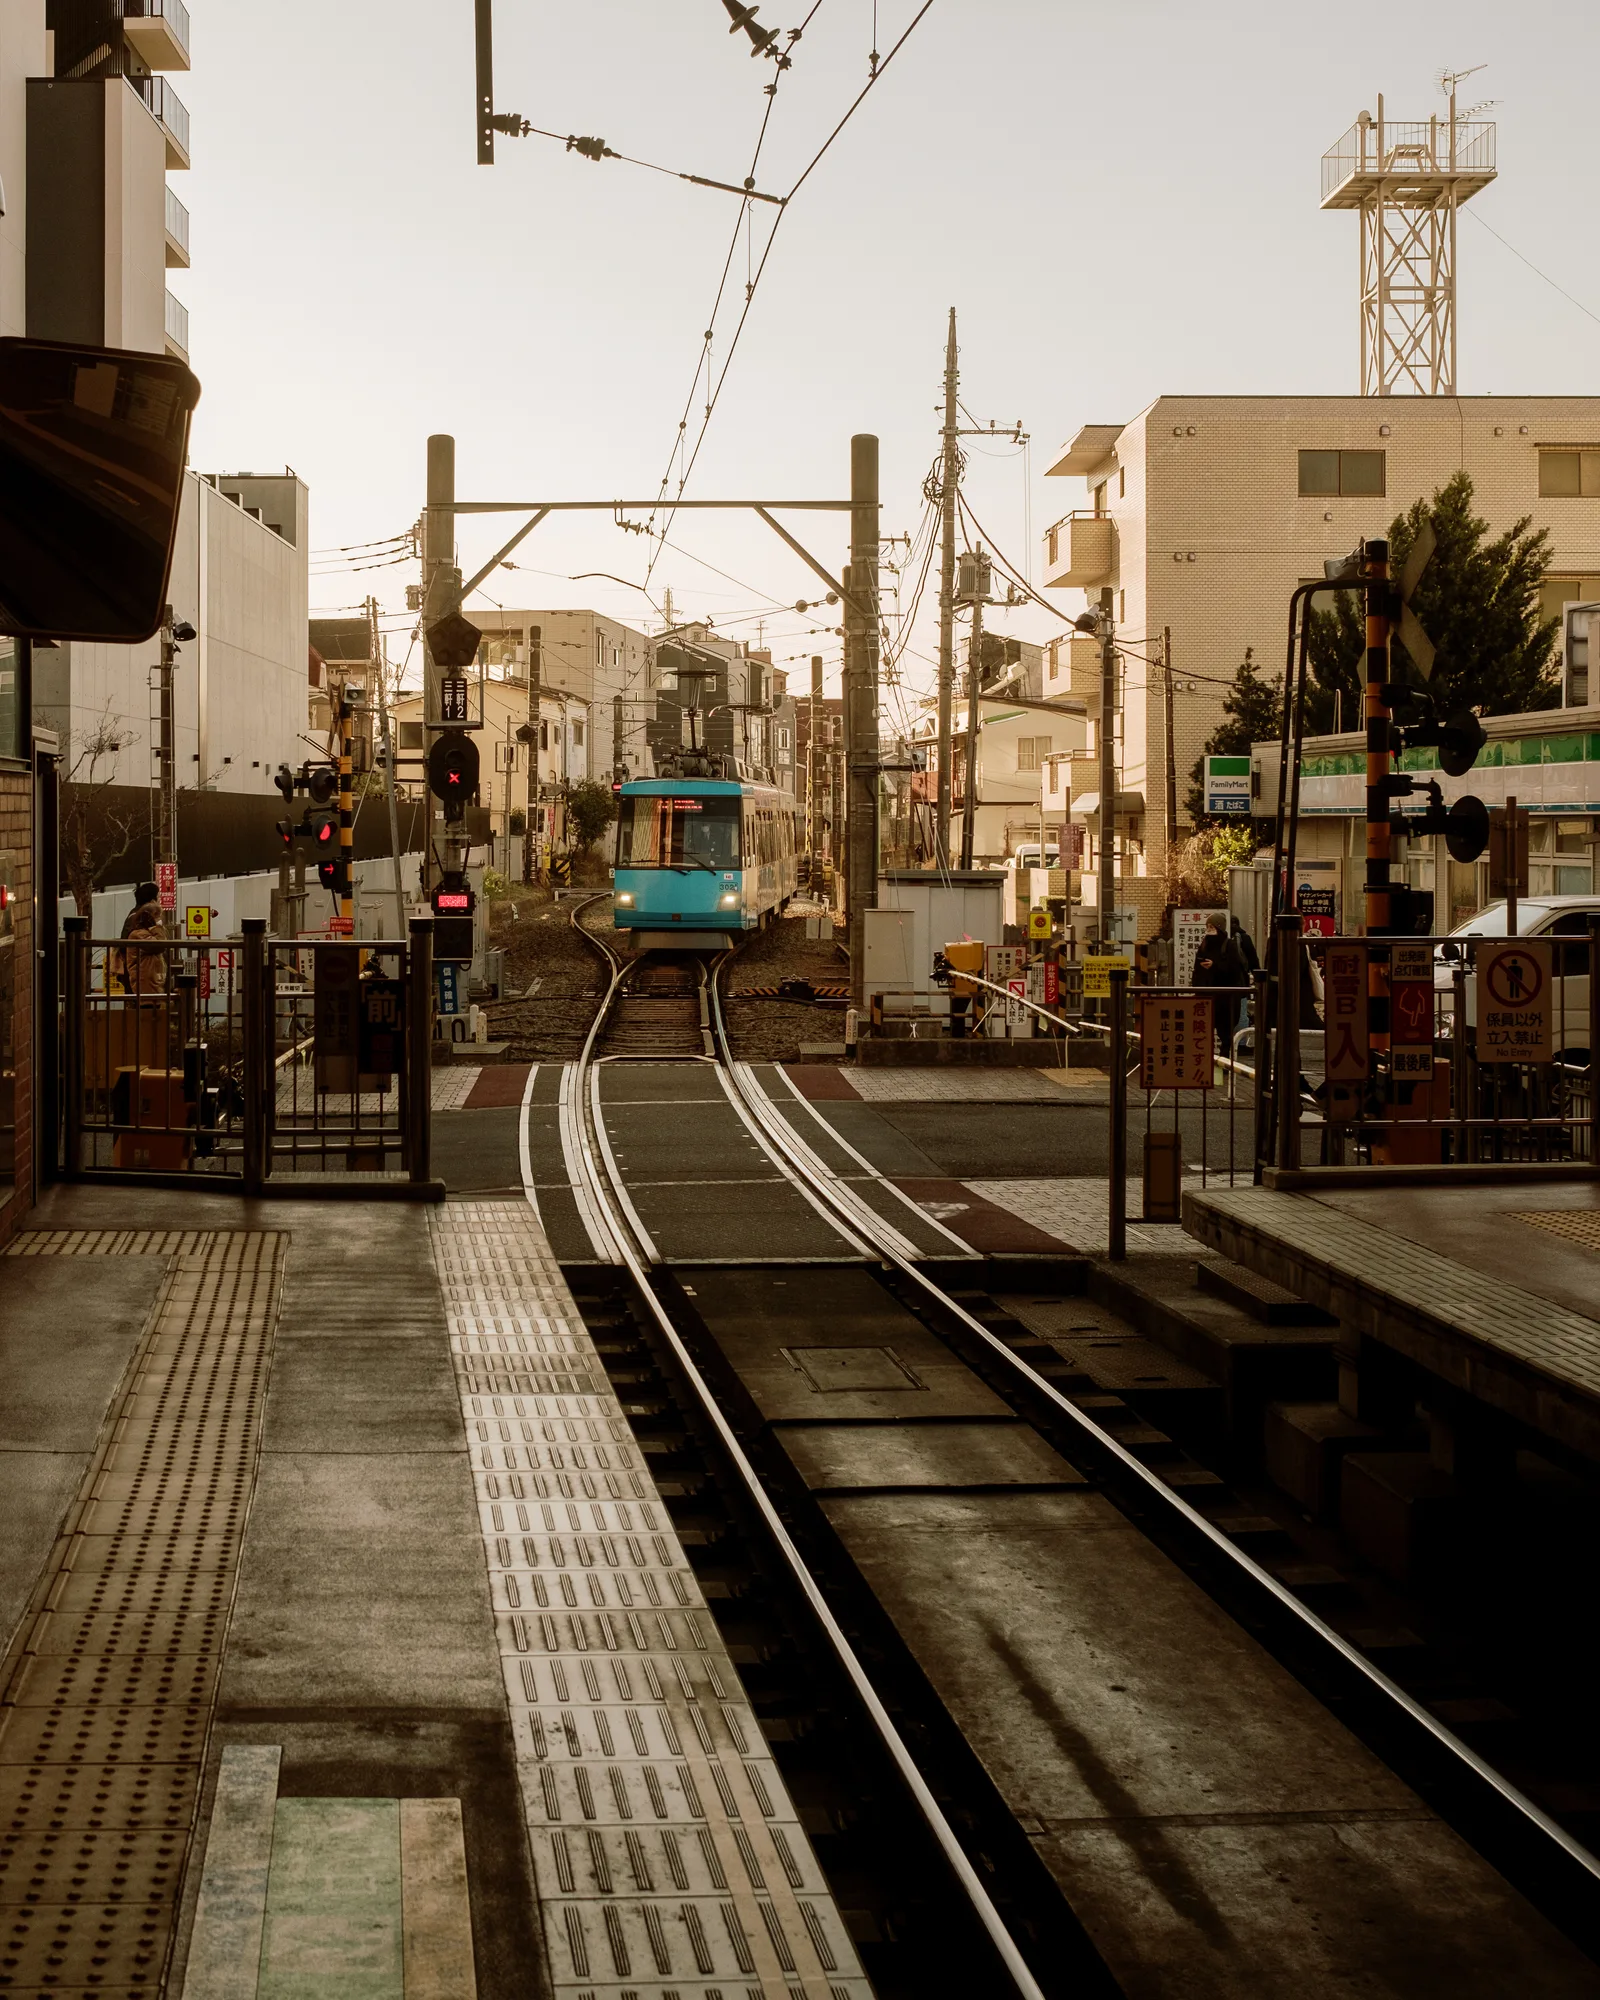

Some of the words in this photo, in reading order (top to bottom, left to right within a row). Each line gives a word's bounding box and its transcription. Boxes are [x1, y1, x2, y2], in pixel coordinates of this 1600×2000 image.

[1215, 800, 1224, 810] 酒
[1226, 801, 1245, 809] たばこ
[1047, 964, 1056, 1001] 非常ボタン
[1486, 1012, 1543, 1027] 係員以外
[1486, 1030, 1543, 1045] 立入禁止
[1496, 1048, 1509, 1056] No
[1511, 1048, 1533, 1057] Entry
[1394, 1054, 1431, 1071] 最後尾
